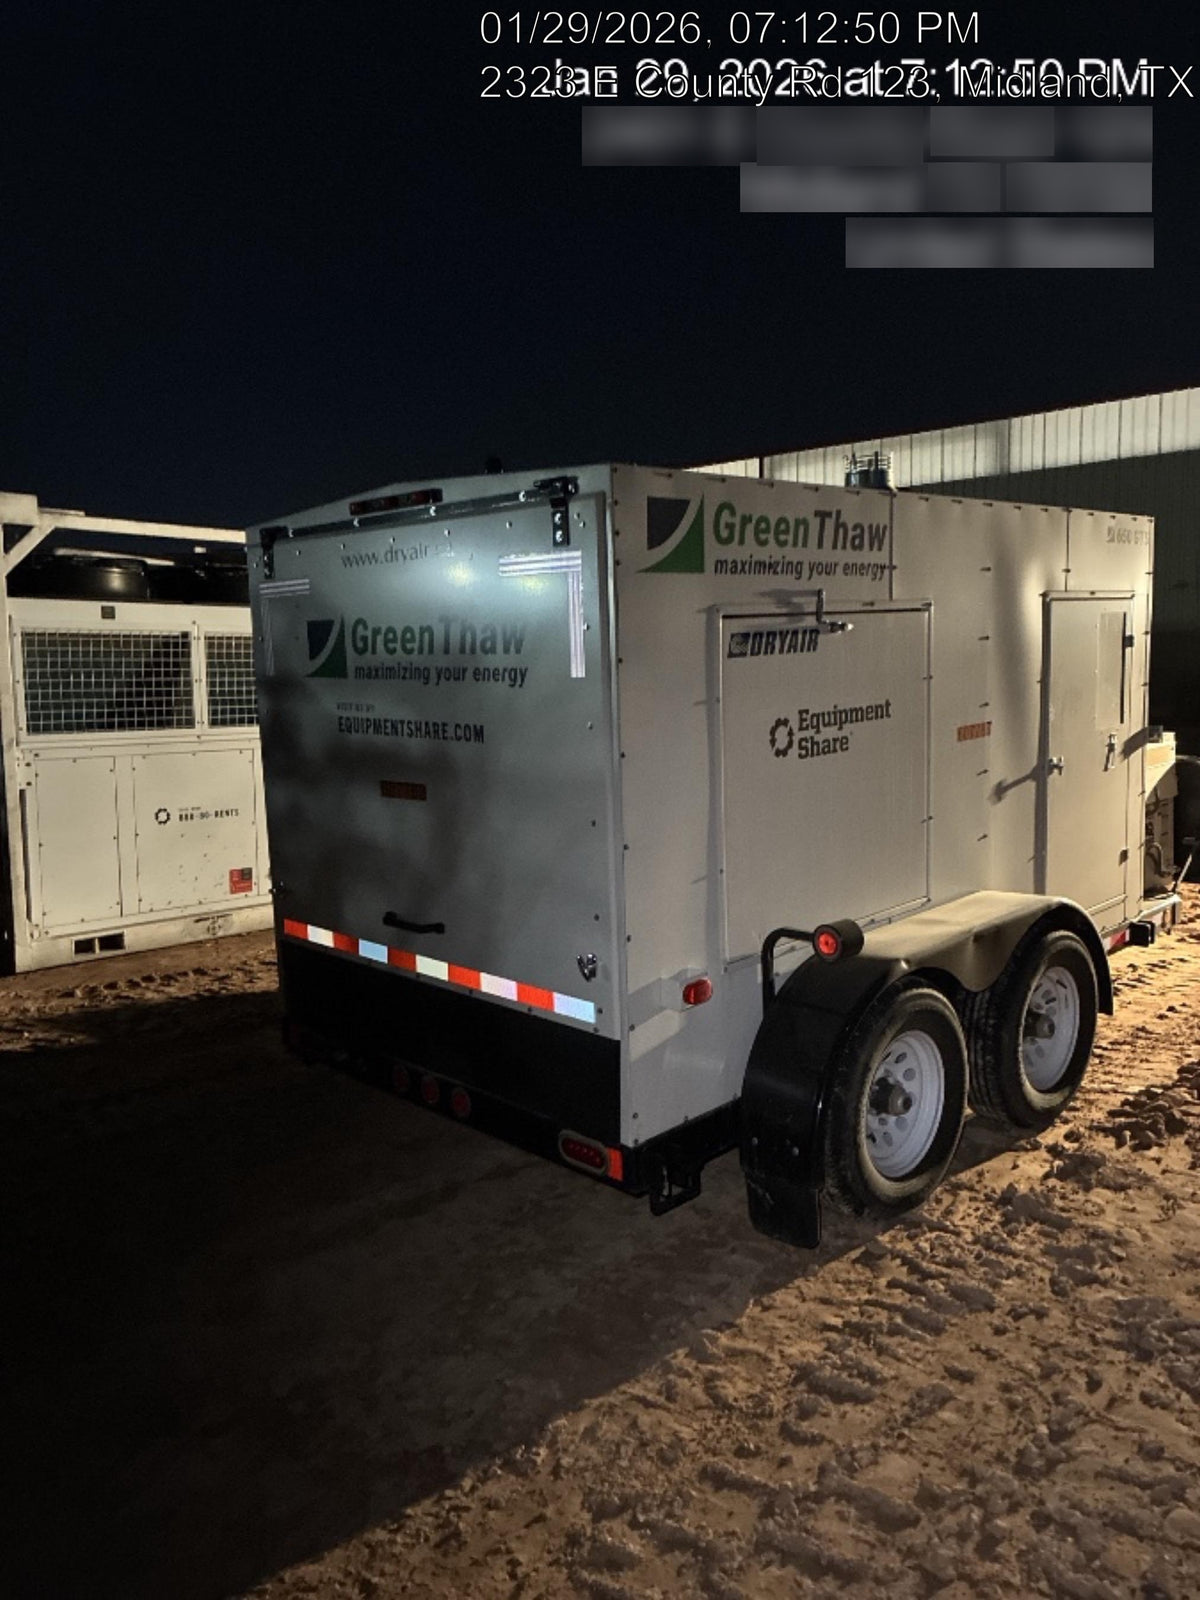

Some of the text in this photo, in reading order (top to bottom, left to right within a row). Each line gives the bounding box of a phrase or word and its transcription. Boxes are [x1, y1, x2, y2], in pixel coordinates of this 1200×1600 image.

[714, 554, 886, 582] maximizing your energy
[749, 629, 820, 657] DRYAIR
[354, 662, 529, 689] maximizing your energy
[338, 716, 485, 743] EQUIPMENTSHARE.COM
[798, 699, 892, 735] Equipment
[798, 736, 849, 760] Share
